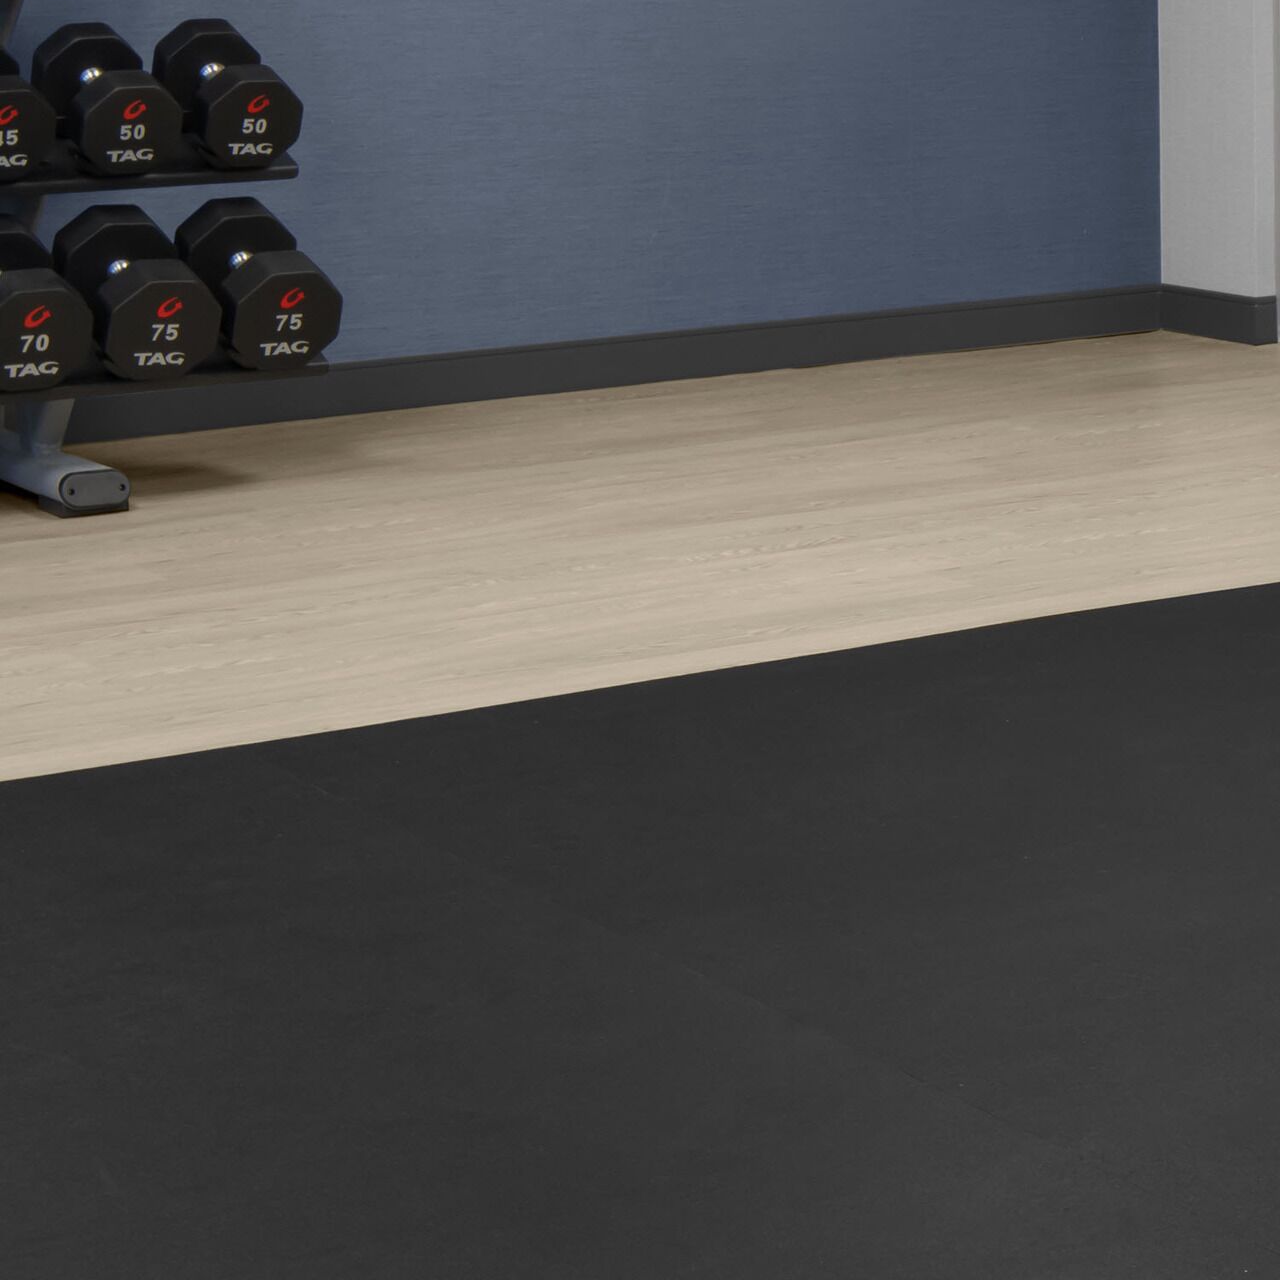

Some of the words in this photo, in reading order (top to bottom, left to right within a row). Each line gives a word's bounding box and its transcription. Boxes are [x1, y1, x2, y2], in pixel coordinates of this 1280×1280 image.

[119, 124, 146, 140] 50
[241, 118, 267, 134] 50
[106, 148, 154, 163] TAG
[228, 142, 273, 155] TAG
[0, 153, 28, 167] AG
[275, 313, 303, 332] 75
[151, 323, 180, 342] 75
[20, 334, 50, 353] 70
[260, 340, 310, 356] TAG
[133, 351, 185, 366] TAG
[4, 361, 60, 378] TAG
